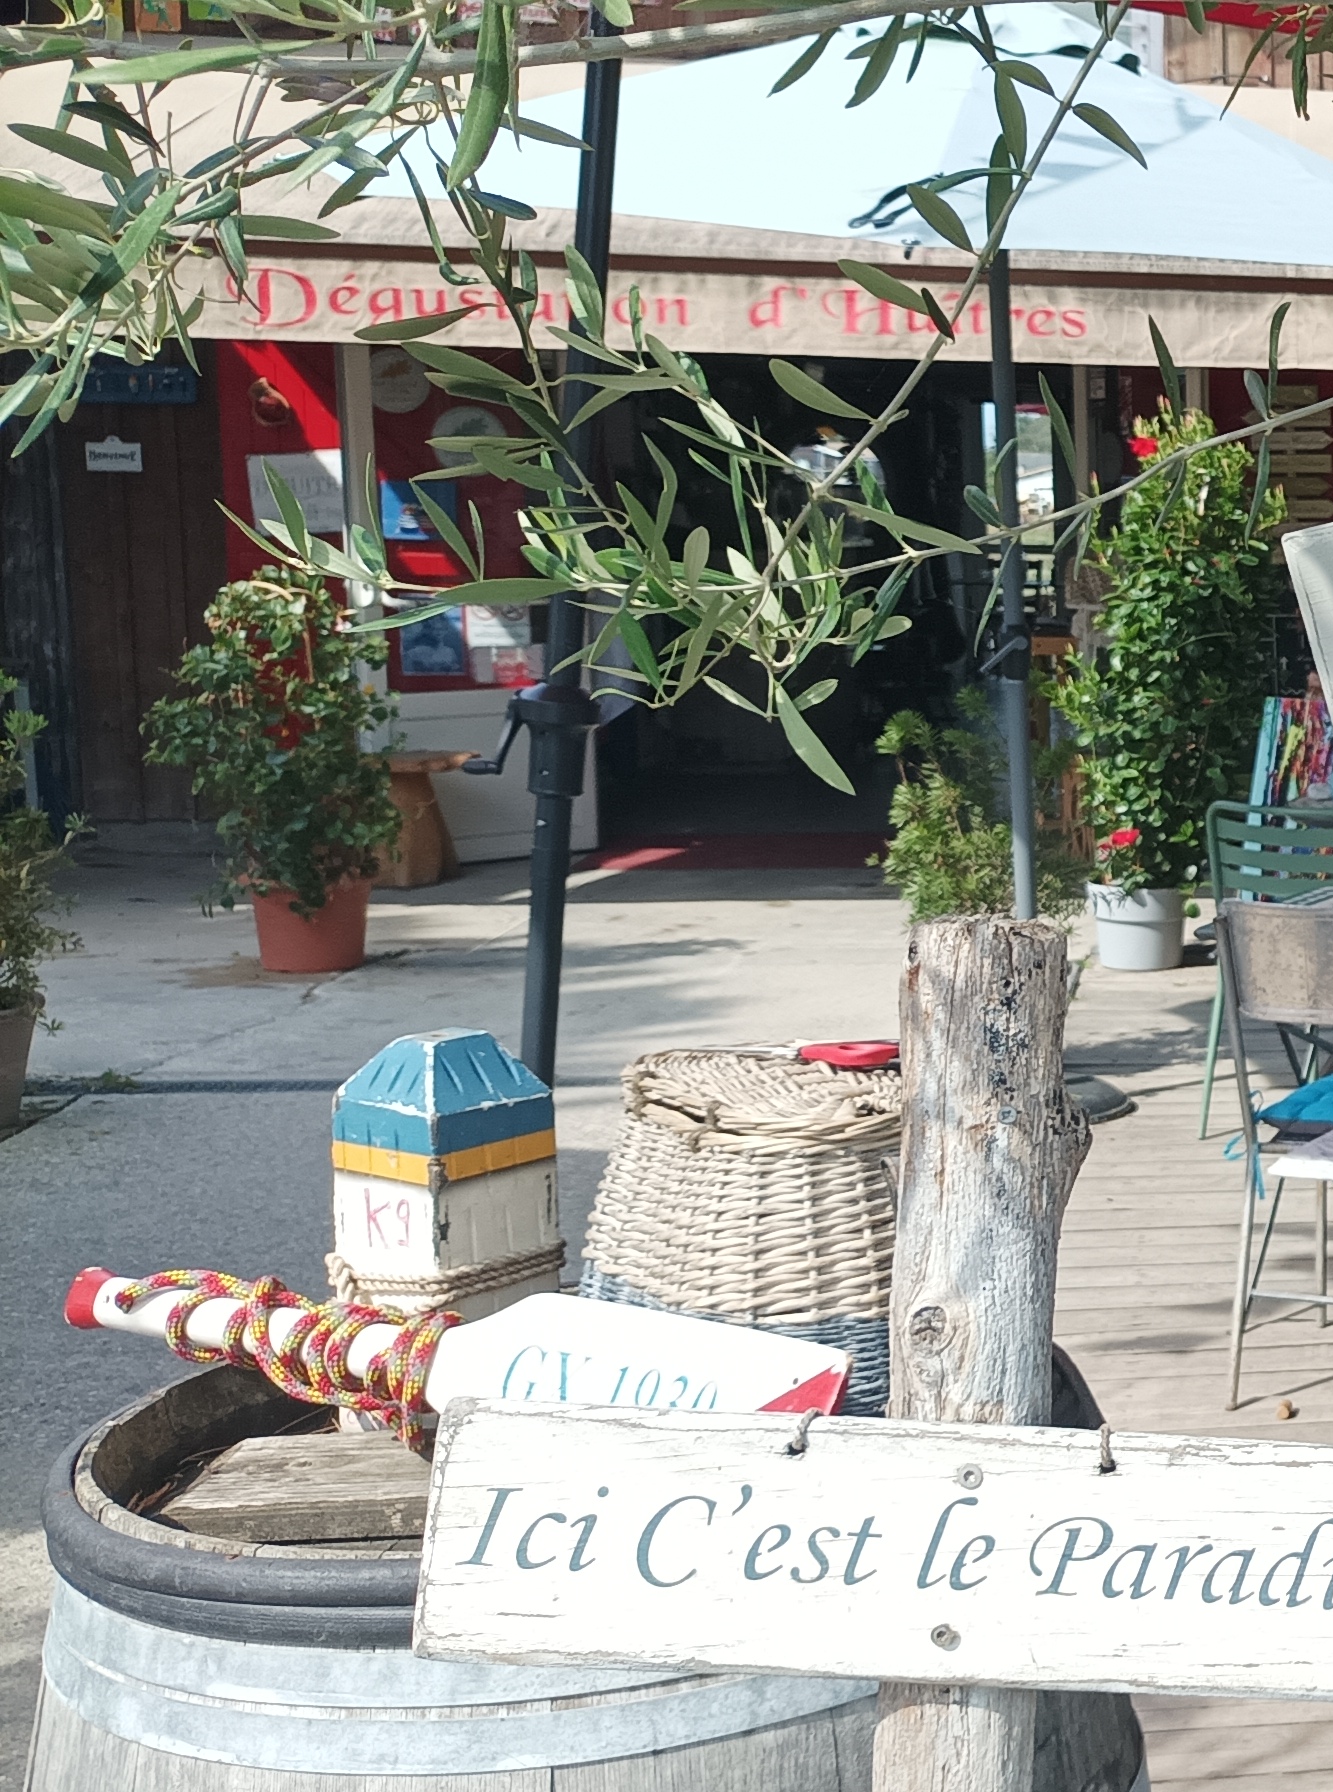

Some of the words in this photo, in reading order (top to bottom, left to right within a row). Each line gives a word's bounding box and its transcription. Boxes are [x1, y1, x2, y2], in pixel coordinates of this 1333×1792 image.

[455, 1485, 610, 1573] Ici
[635, 1483, 880, 1588] C'est
[917, 1496, 995, 1593] le
